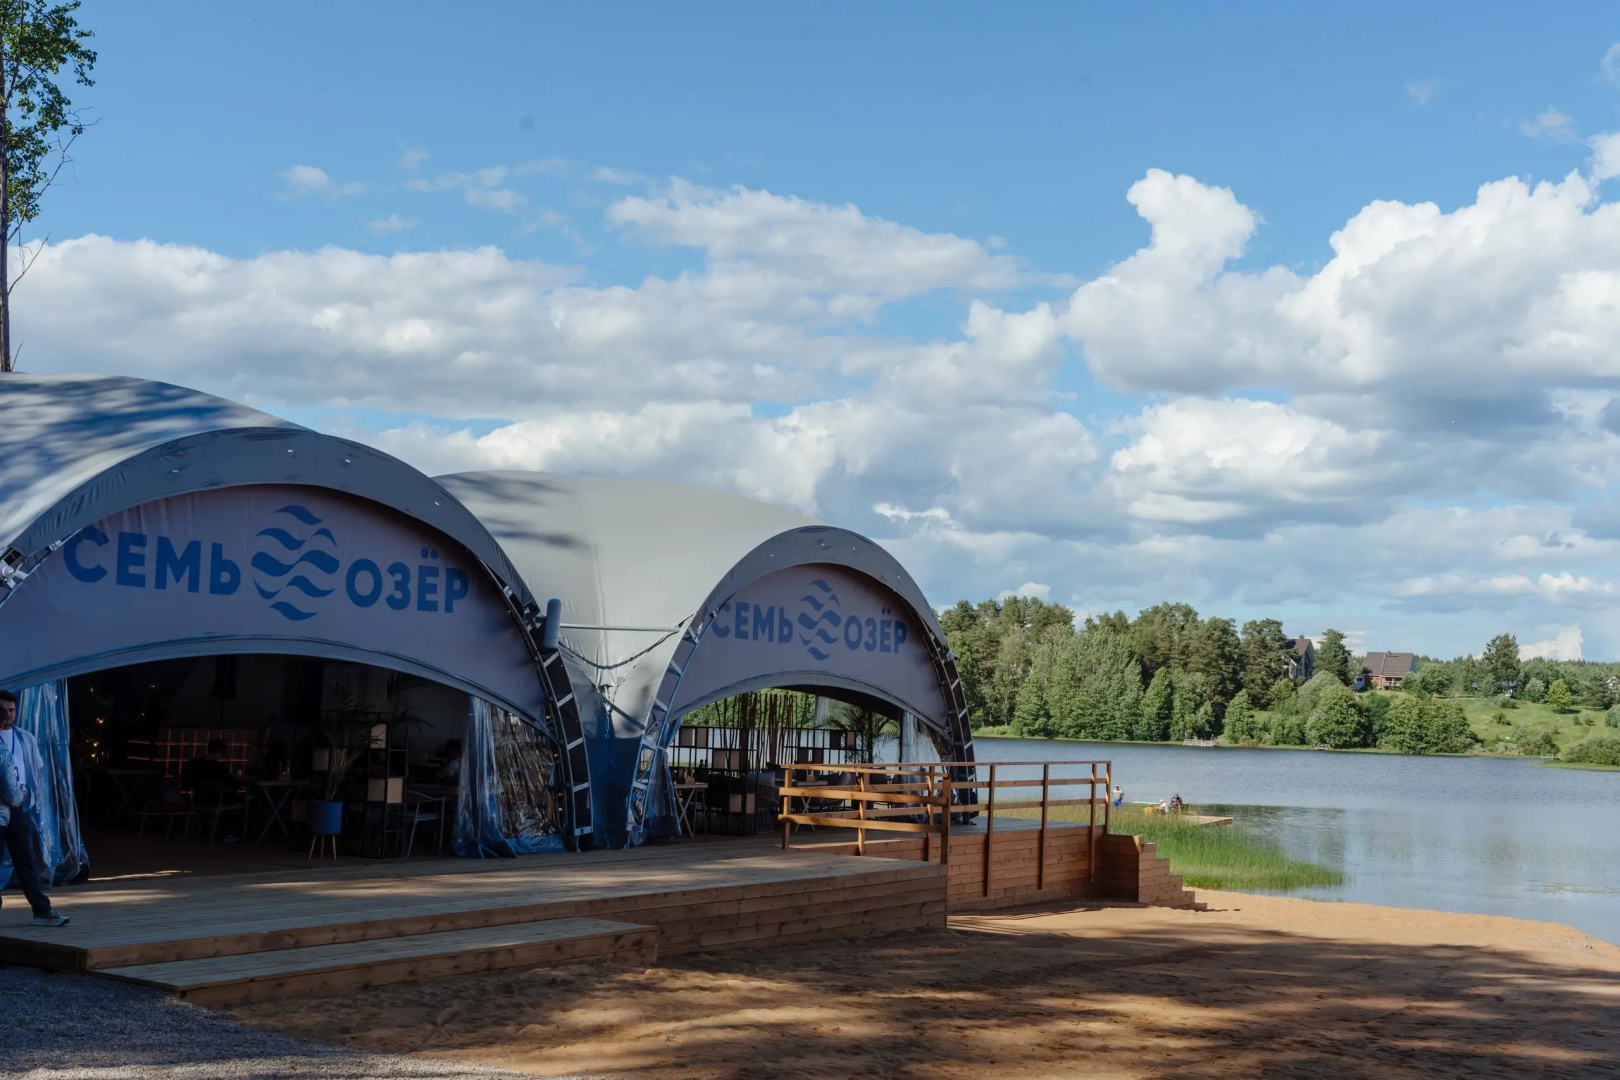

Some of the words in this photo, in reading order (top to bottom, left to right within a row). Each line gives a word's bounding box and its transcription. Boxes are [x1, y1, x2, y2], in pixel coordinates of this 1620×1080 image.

[63, 526, 241, 595] СЕМЬ
[346, 548, 469, 613] ОЗЁР
[712, 602, 793, 643] СЕМЬ
[844, 607, 907, 653] ОЗЁР
